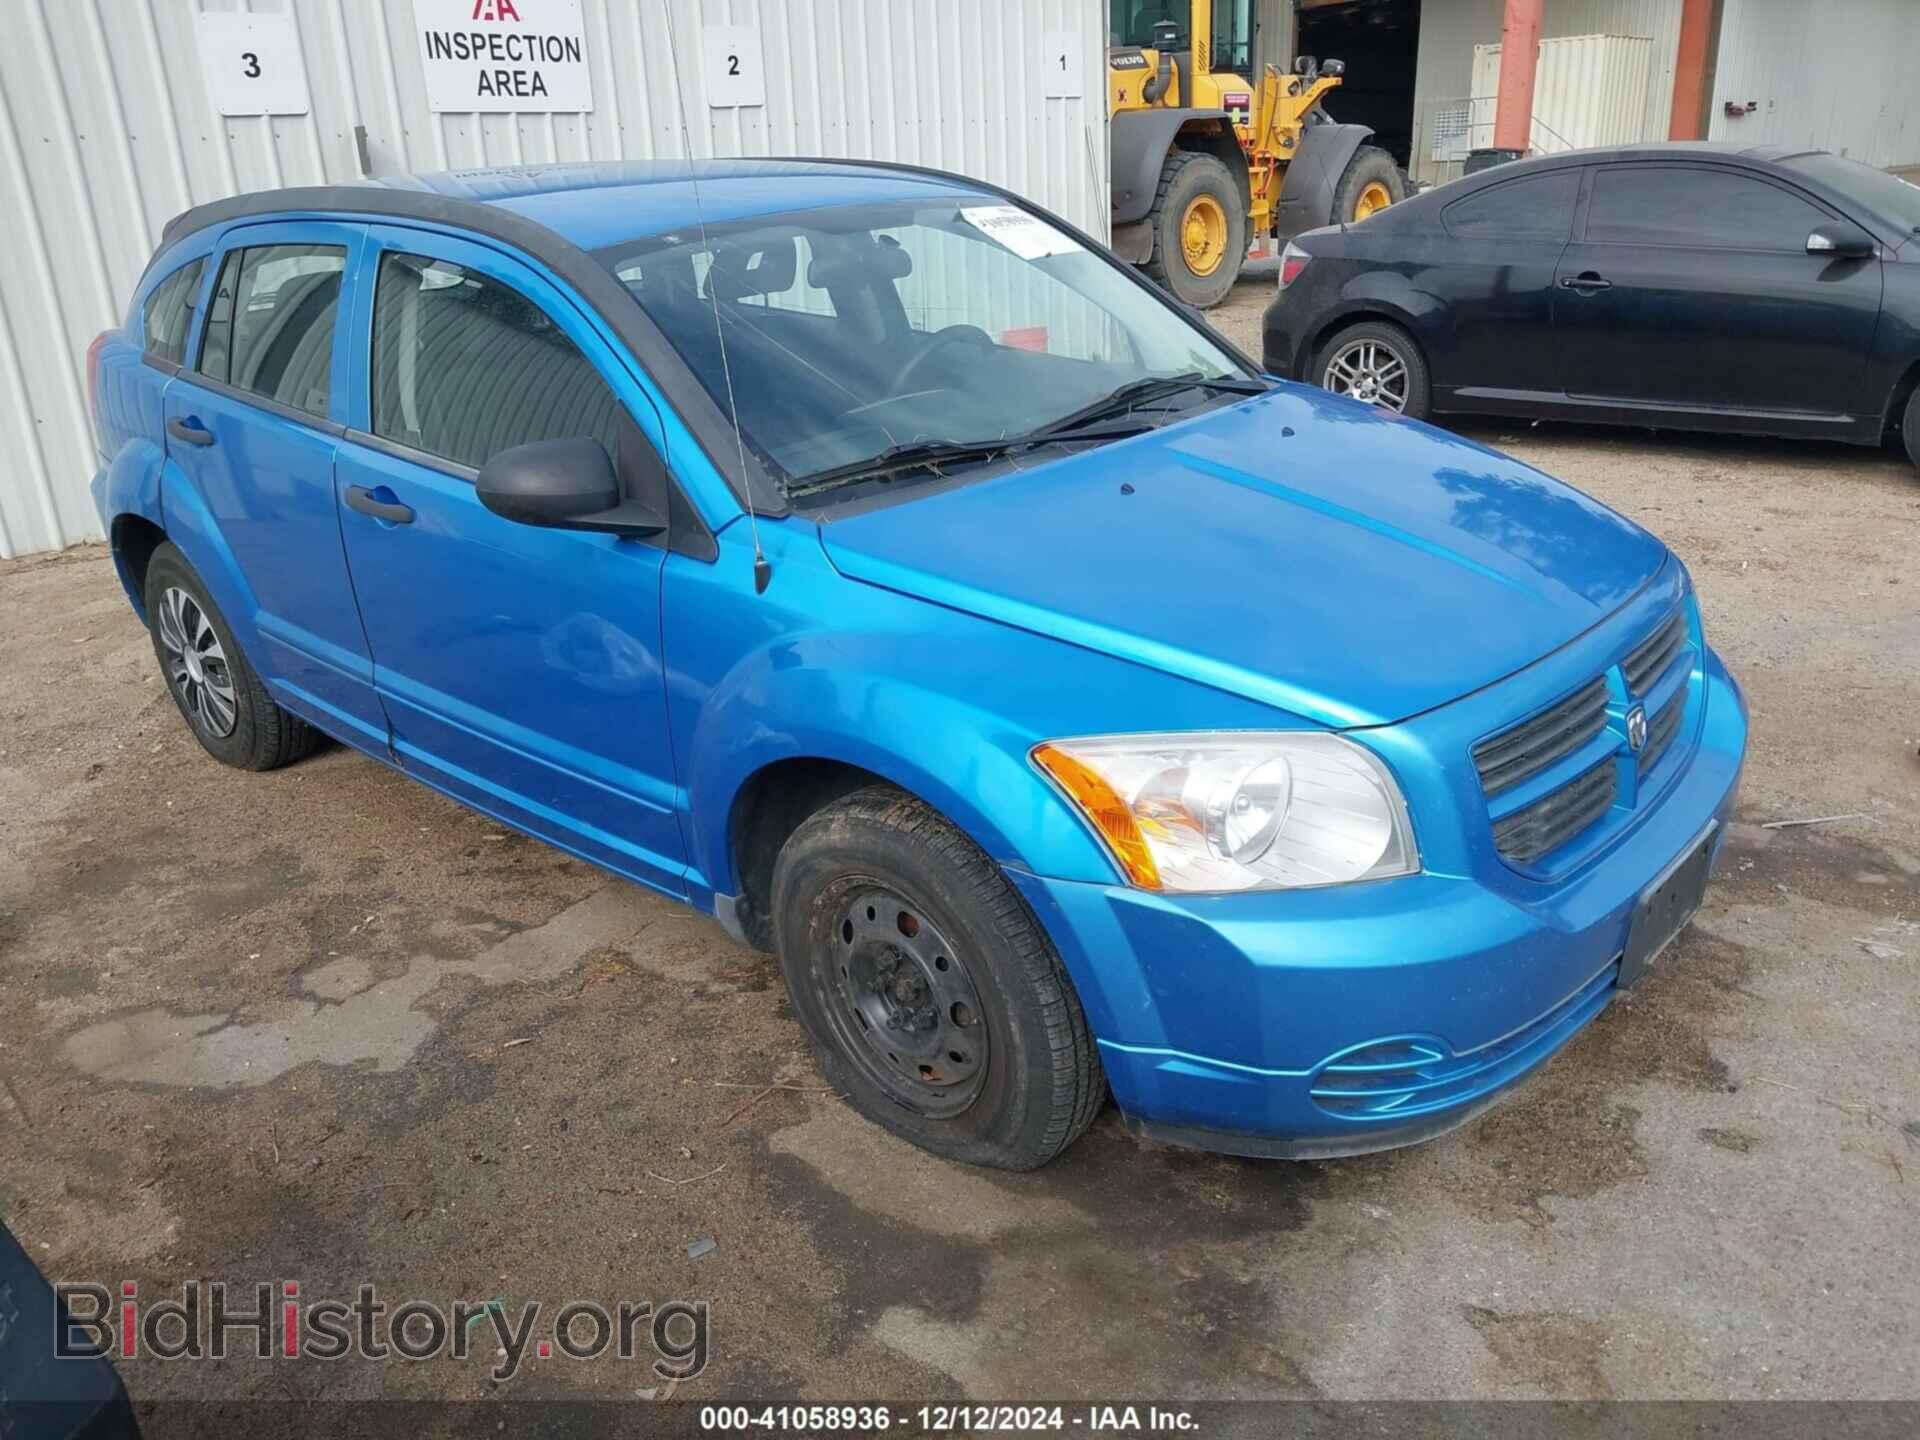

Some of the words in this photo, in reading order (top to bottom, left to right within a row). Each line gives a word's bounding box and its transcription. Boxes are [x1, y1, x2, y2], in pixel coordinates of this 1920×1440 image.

[425, 31, 582, 63] INSPECTION
[241, 52, 261, 78] 3
[727, 55, 740, 76] 2
[1059, 54, 1066, 71] 1
[477, 69, 549, 97] AREA
